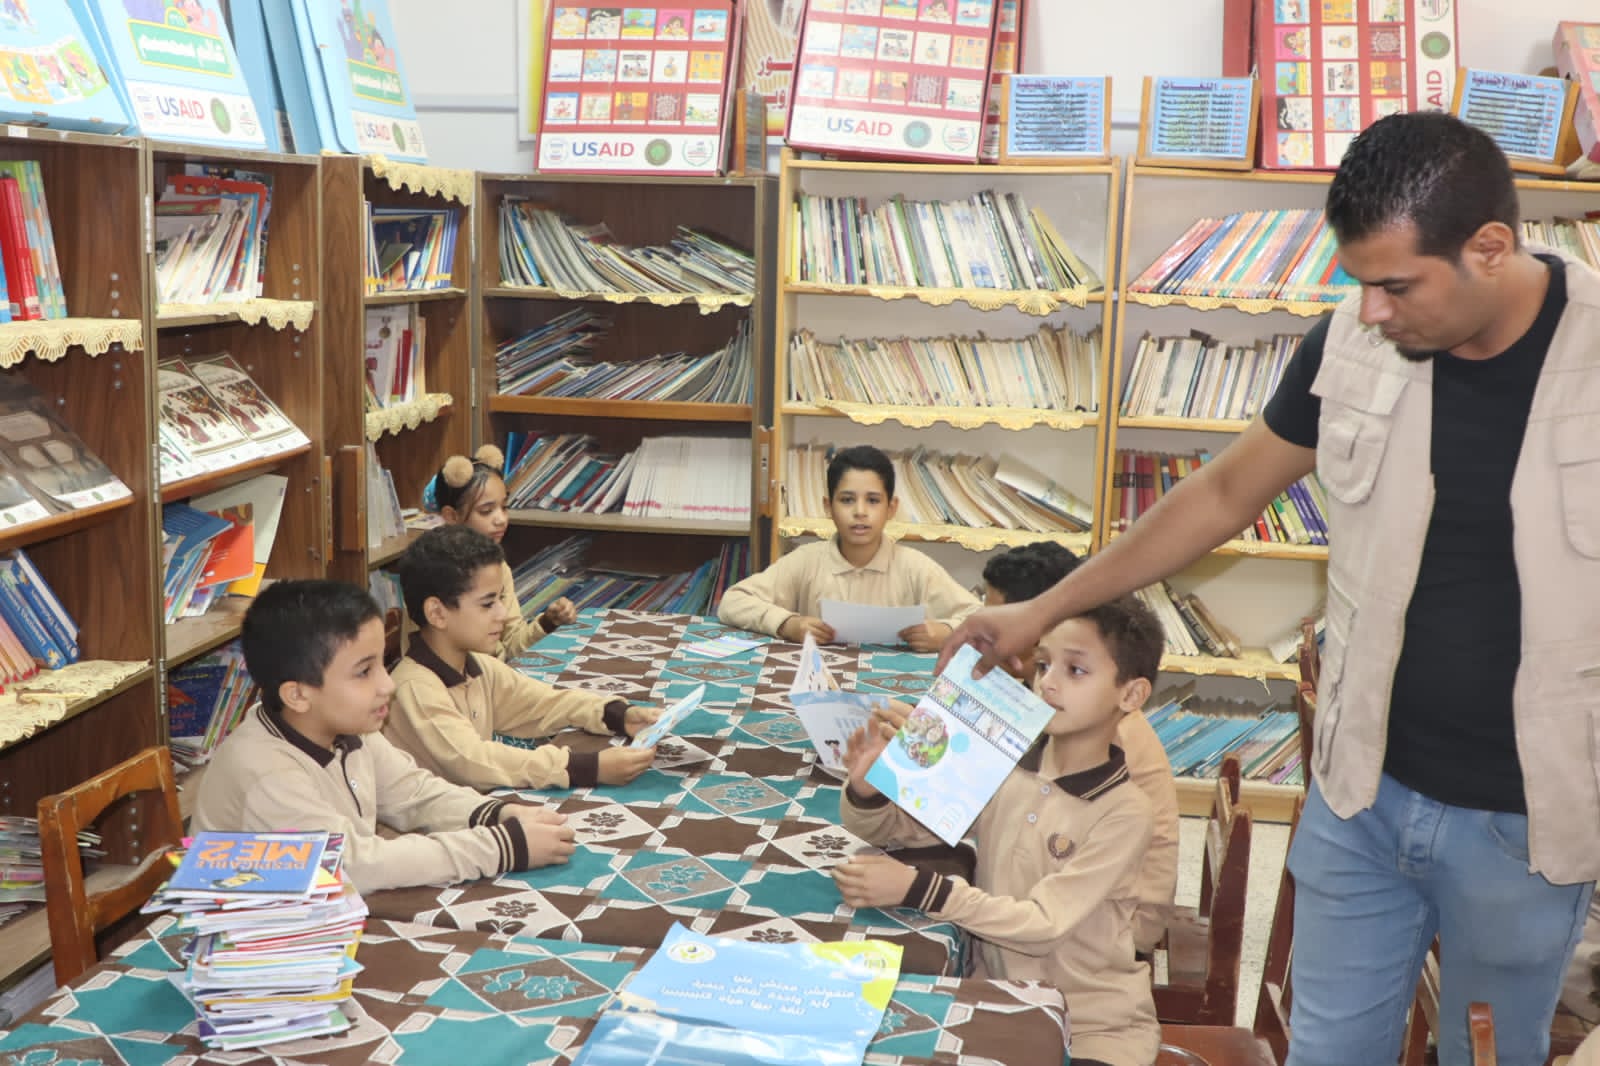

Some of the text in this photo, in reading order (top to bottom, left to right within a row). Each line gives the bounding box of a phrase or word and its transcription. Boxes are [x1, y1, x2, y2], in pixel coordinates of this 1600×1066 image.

[156, 96, 205, 120] USAID
[827, 116, 893, 137] USAID
[572, 141, 635, 158] USAID
[197, 840, 313, 864] ME 2
